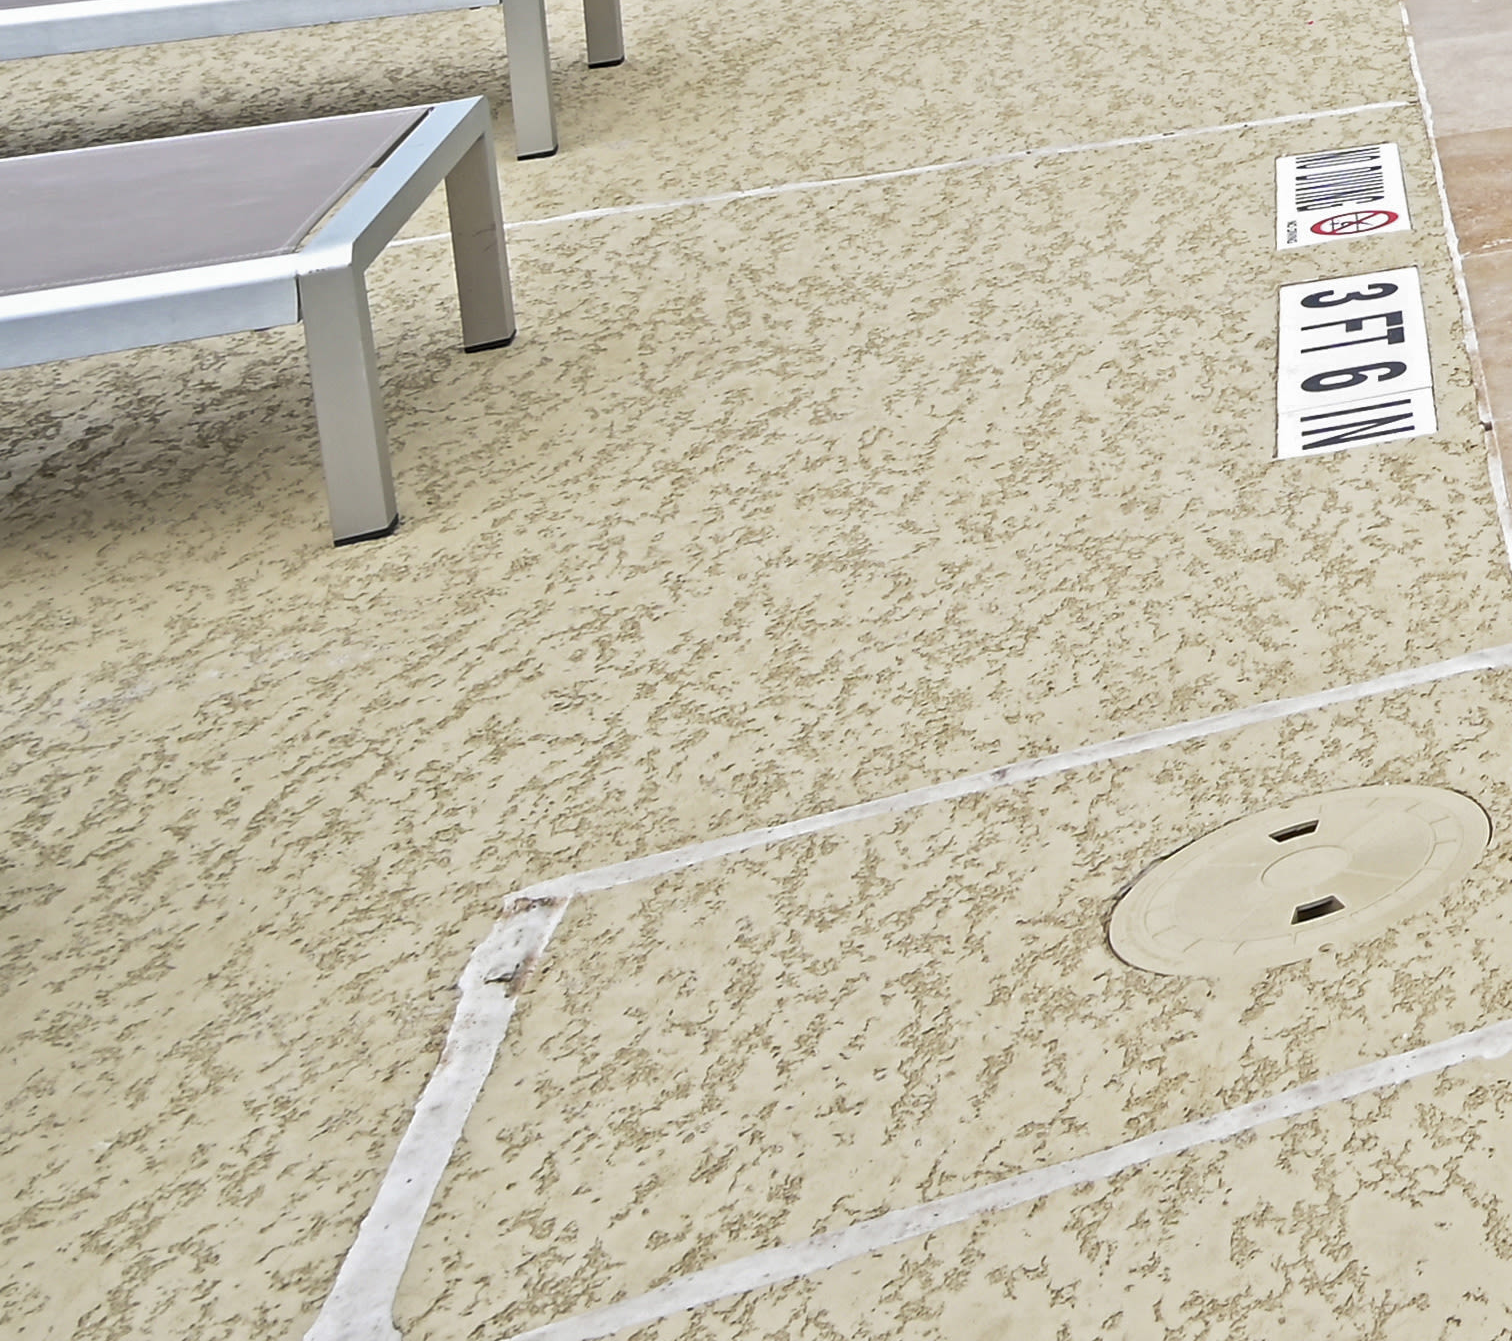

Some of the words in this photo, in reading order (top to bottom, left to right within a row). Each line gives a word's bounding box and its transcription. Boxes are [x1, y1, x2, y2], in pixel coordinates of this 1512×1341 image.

[1295, 147, 1381, 169] NO
[1295, 165, 1385, 212] DIVING
[1300, 282, 1398, 308] 3
[1300, 310, 1405, 354] FT
[1300, 361, 1407, 392] 6
[1300, 399, 1415, 450] IN
